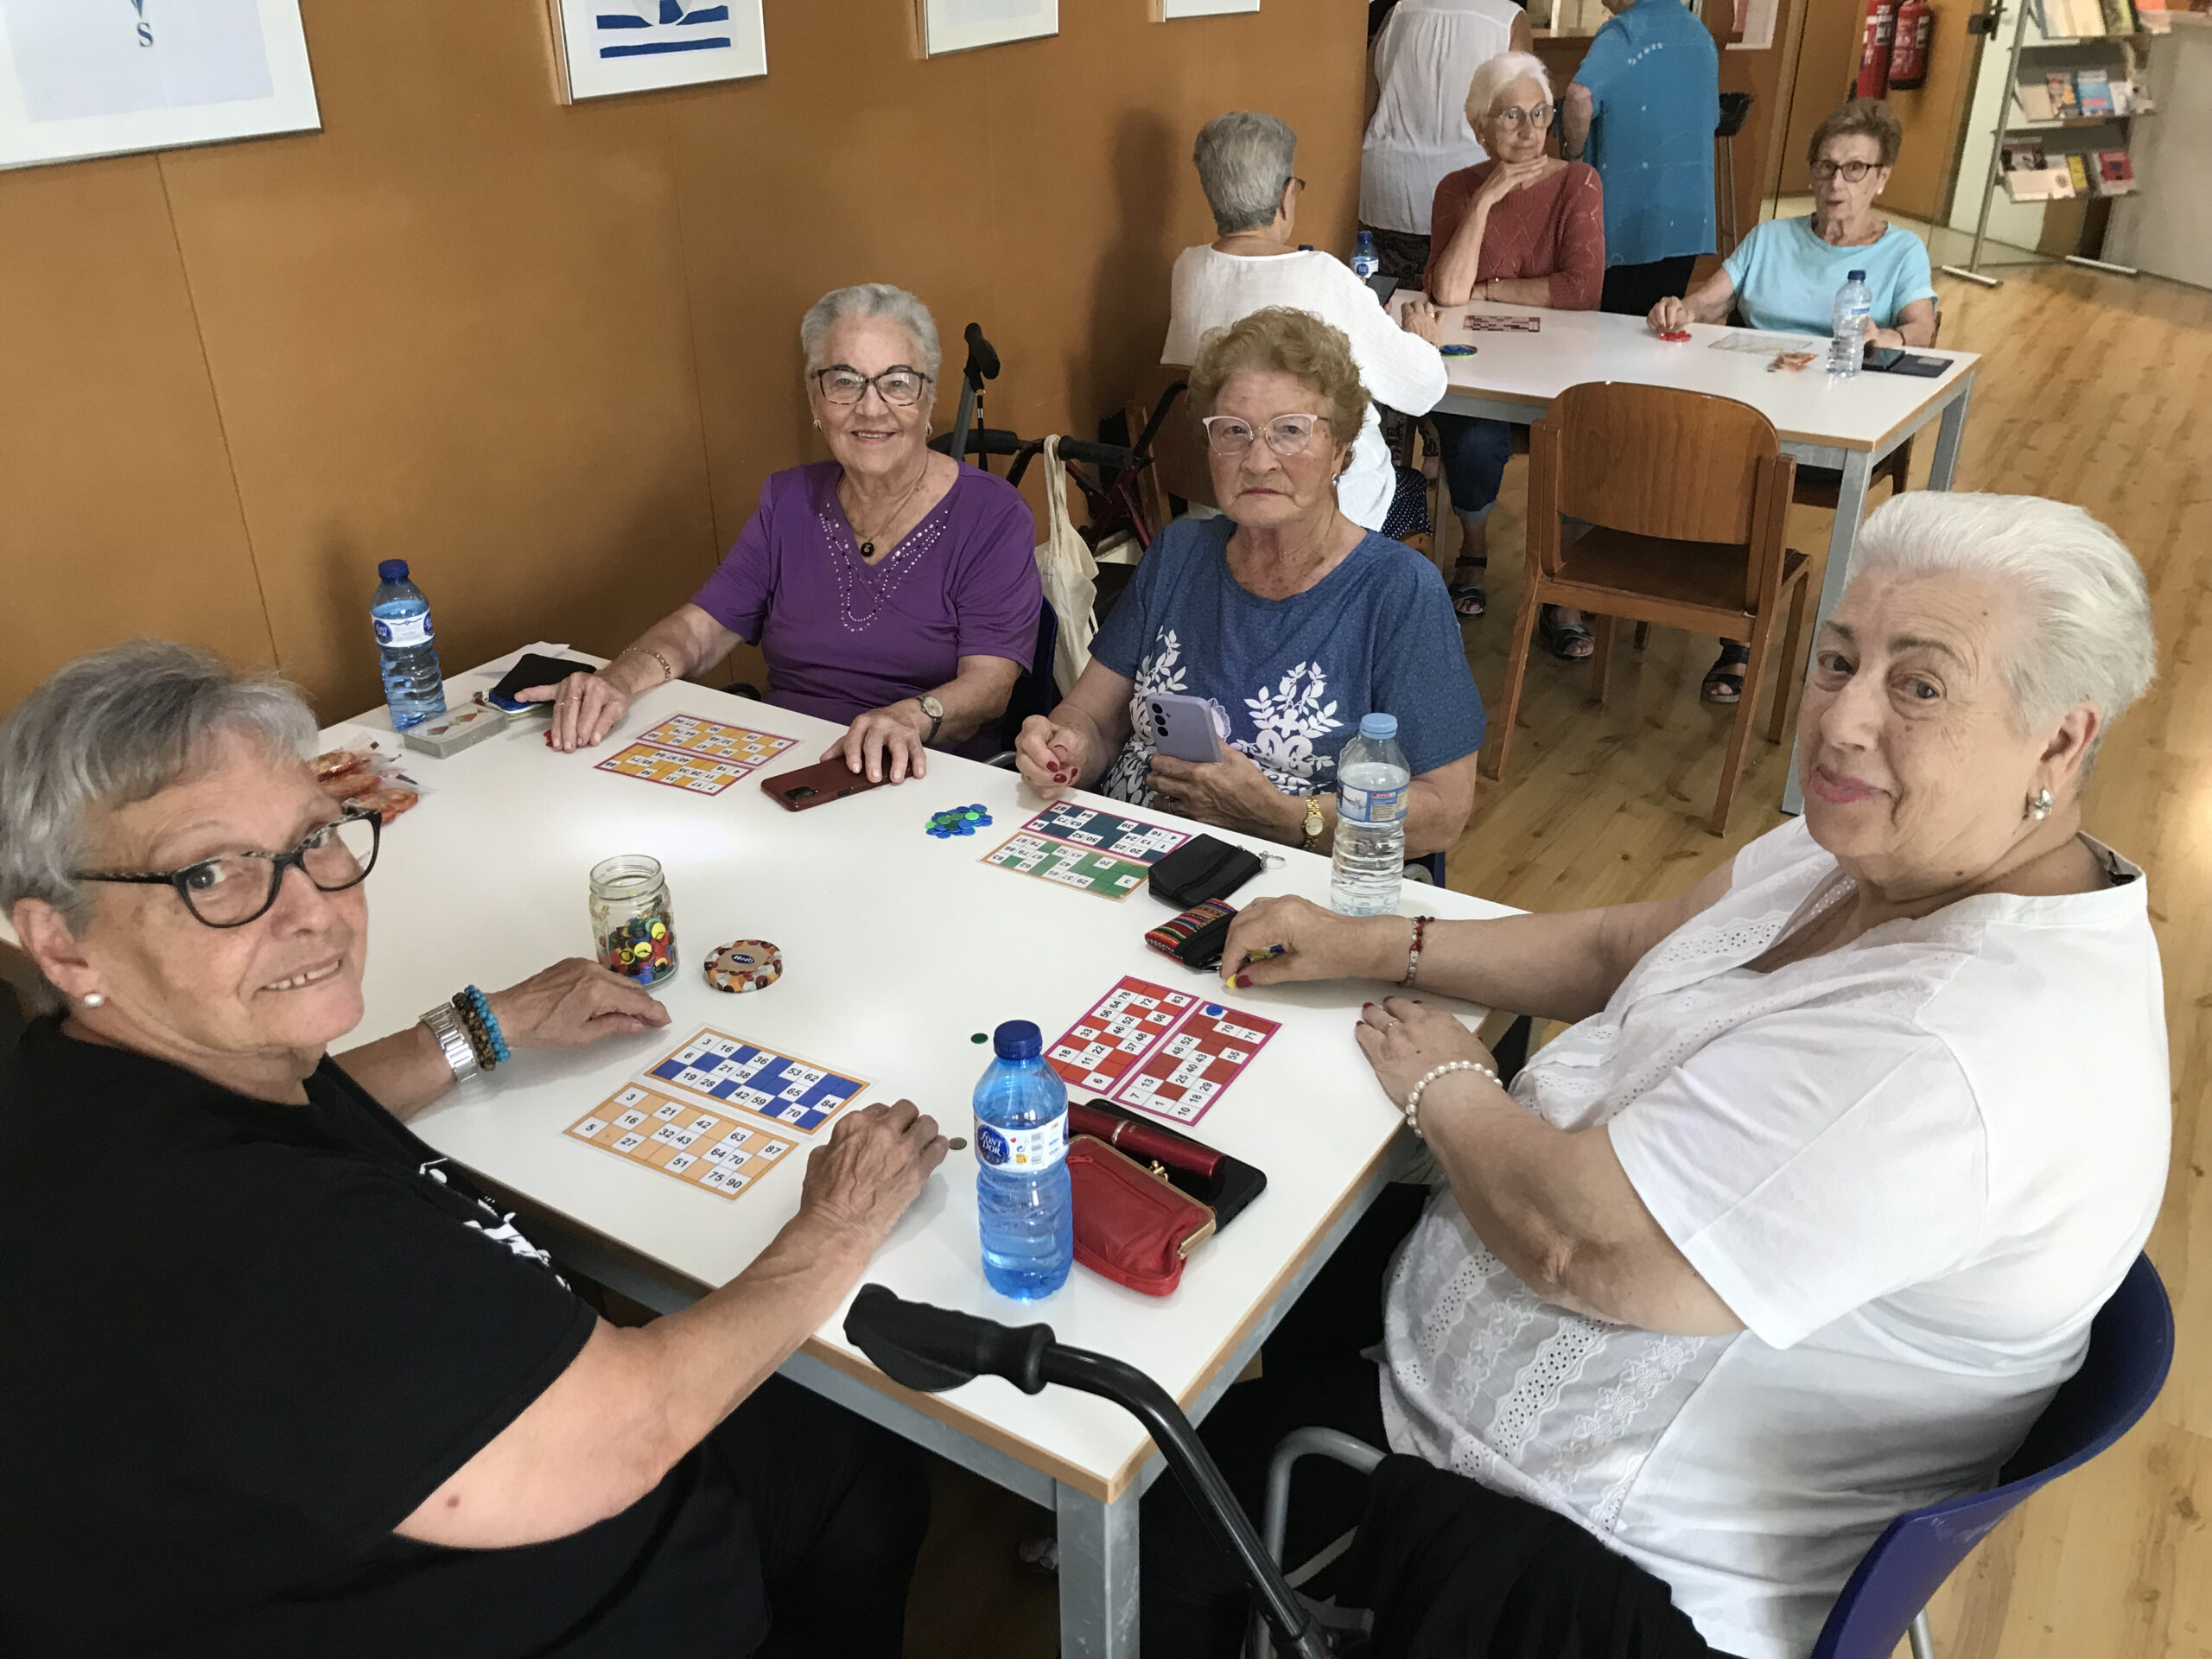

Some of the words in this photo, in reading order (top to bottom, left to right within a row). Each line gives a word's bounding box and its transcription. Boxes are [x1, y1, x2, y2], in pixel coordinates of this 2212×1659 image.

[137, 22, 154, 48] S
[733, 954, 754, 963] Hero
[1058, 1049, 1071, 1058] 18
[1079, 1028, 1093, 1038] 33
[1099, 1009, 1113, 1018] 56
[1109, 1000, 1122, 1009] 64
[1118, 991, 1131, 1000] 78
[1081, 1057, 1094, 1065] 11
[1091, 1045, 1106, 1055] 22
[1112, 1026, 1125, 1035] 46
[1121, 1016, 1135, 1025] 52
[1140, 998, 1154, 1007] 72
[1124, 1042, 1137, 1052] 37
[1135, 1033, 1147, 1042] 48
[1153, 1014, 1166, 1022] 66
[1171, 995, 1184, 1004] 83
[720, 1044, 734, 1053] 16
[753, 1056, 769, 1065] 36
[786, 1067, 803, 1077] 53
[804, 1073, 820, 1083] 62
[1141, 1078, 1154, 1087] 13
[1172, 1046, 1185, 1056] 48
[1179, 1036, 1194, 1046] 52
[1175, 1074, 1189, 1084] 25
[1185, 1064, 1198, 1073] 40
[1195, 1053, 1208, 1063] 43
[1220, 1024, 1235, 1033] 70
[1177, 1107, 1191, 1116] 10
[1189, 1094, 1203, 1103] 18
[1198, 1082, 1213, 1092] 29
[1227, 1051, 1240, 1060] 55
[1243, 1031, 1257, 1040] 71
[683, 1072, 697, 1081] 19
[699, 1078, 716, 1088] 28
[734, 1090, 750, 1100] 42
[751, 1096, 766, 1106] 59
[785, 1108, 802, 1118] 70
[718, 1064, 734, 1073] 21
[735, 1070, 752, 1079] 38
[786, 1087, 803, 1096] 65
[820, 1099, 836, 1109] 84
[624, 1115, 639, 1124] 16
[658, 1128, 675, 1139] 32
[676, 1135, 692, 1145] 43
[710, 1147, 727, 1159] 64
[728, 1154, 745, 1165] 70
[660, 1107, 677, 1116] 21
[696, 1120, 712, 1129] 42
[729, 1132, 747, 1142] 63
[765, 1145, 782, 1154] 87
[620, 1137, 638, 1147] 27
[672, 1157, 689, 1168] 51
[709, 1171, 725, 1182] 75
[726, 1178, 743, 1189] 90
